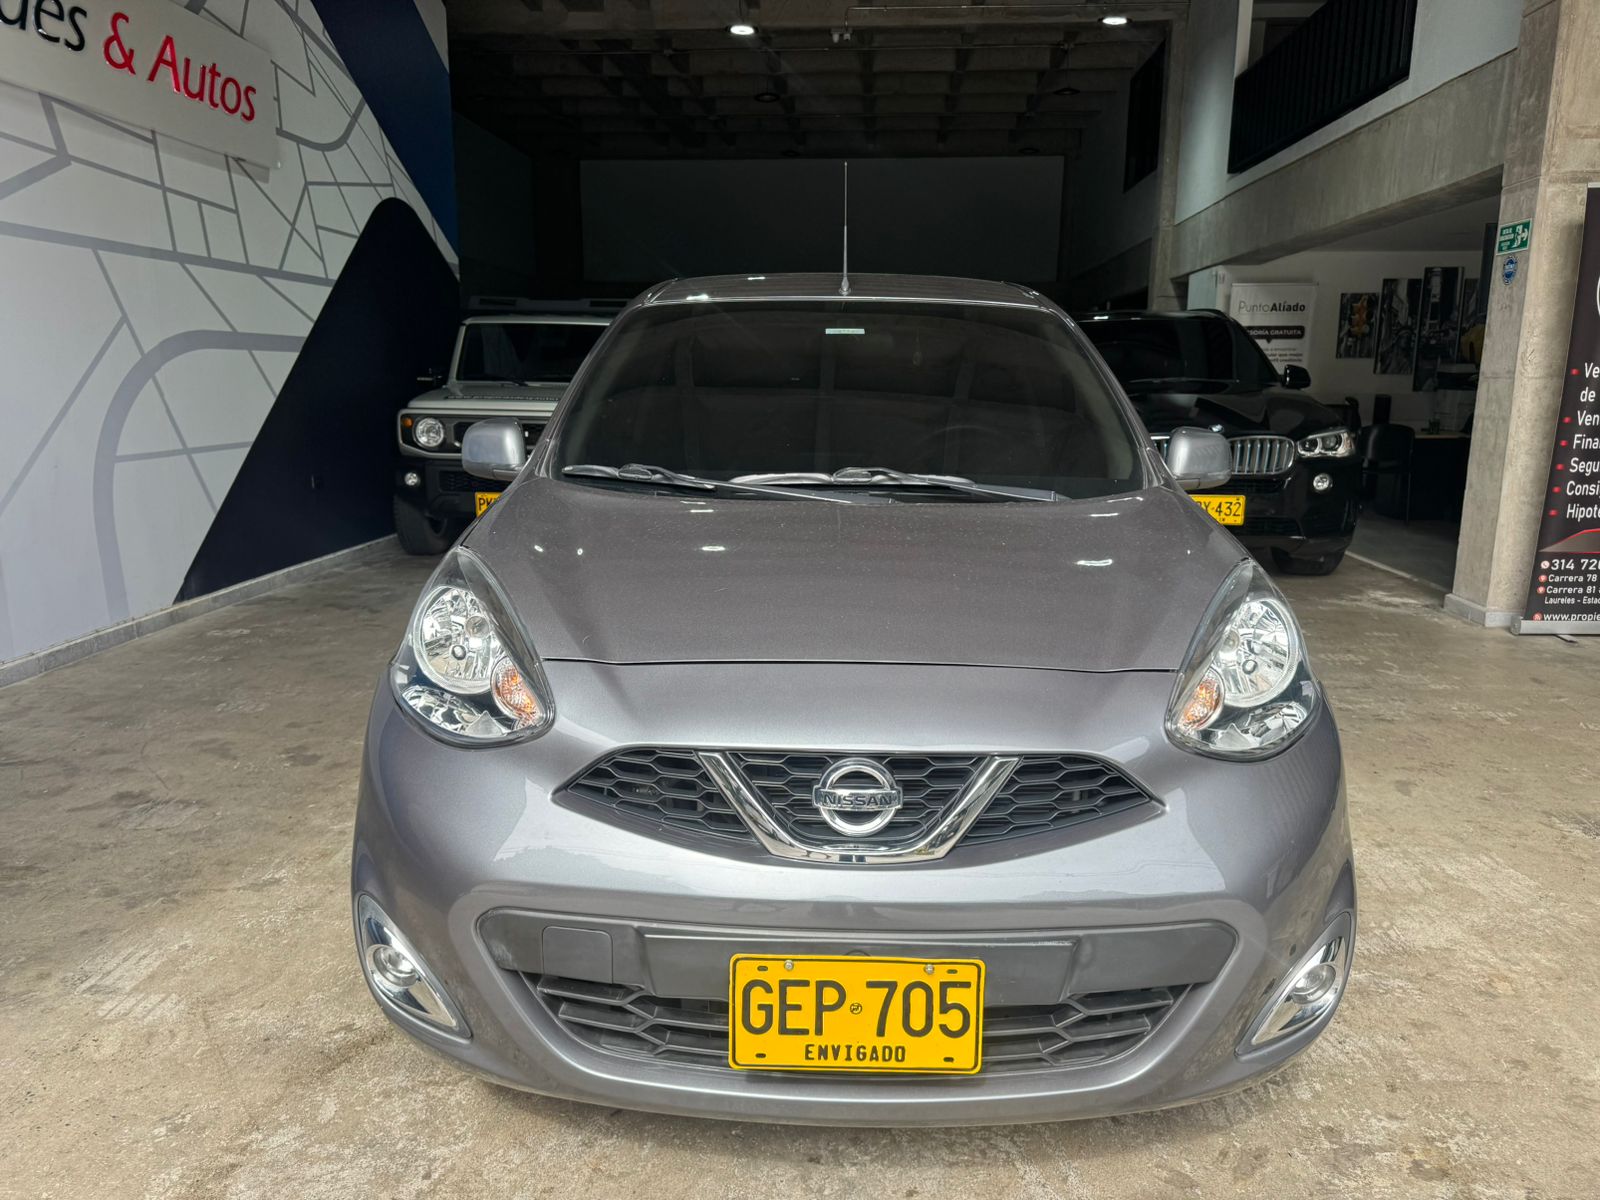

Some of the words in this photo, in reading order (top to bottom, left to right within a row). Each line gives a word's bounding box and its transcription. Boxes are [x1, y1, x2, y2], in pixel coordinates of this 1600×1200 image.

[103, 12, 136, 75] &
[146, 34, 257, 121] Autos
[1584, 362, 1600, 378] Ve
[1580, 386, 1596, 402] de
[1577, 410, 1600, 426] Ven
[1569, 457, 1600, 476] Segu
[1566, 480, 1600, 498] Consi
[1215, 501, 1242, 517] 432
[1551, 559, 1575, 571] 314
[1548, 574, 1584, 582] Carrera
[1586, 573, 1598, 582] 78
[1546, 585, 1583, 594] Carrera
[1586, 585, 1596, 594] 81
[1544, 596, 1575, 605] Laureles
[823, 792, 892, 807] NISSAN
[741, 979, 847, 1036] GEP
[865, 980, 972, 1039] 705
[804, 1043, 906, 1063] ENVIGADO
